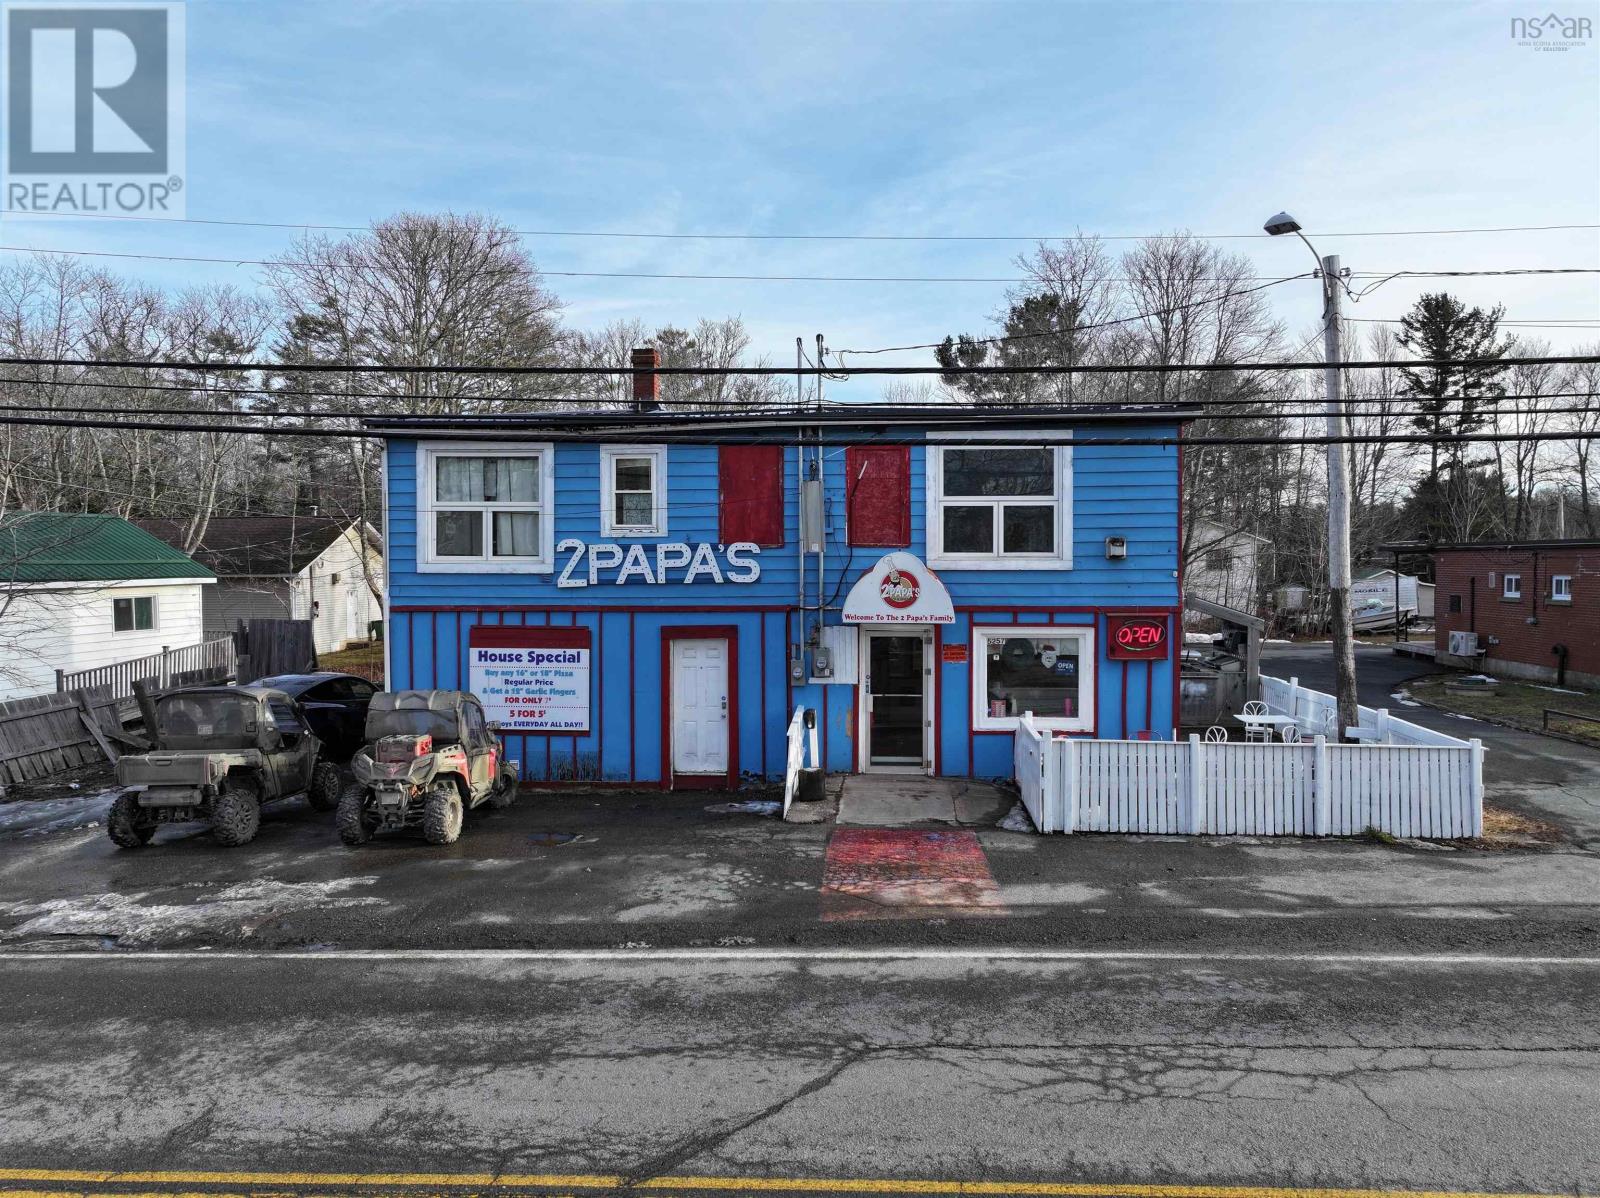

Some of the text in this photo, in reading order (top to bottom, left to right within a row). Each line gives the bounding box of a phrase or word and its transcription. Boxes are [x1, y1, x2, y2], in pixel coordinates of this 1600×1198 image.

[844, 613, 874, 621] Welcome
[876, 613, 884, 621] To
[886, 613, 899, 621] The
[906, 614, 927, 622] Papa's
[930, 614, 954, 622] Family
[1118, 627, 1161, 643] OPEN
[478, 650, 581, 665] House Special
[1057, 662, 1074, 670] OPEN
[484, 669, 499, 677] Buy
[525, 687, 548, 695] Garlic
[549, 688, 576, 696] Fingers
[510, 710, 515, 718] 5
[517, 710, 536, 718] FOR
